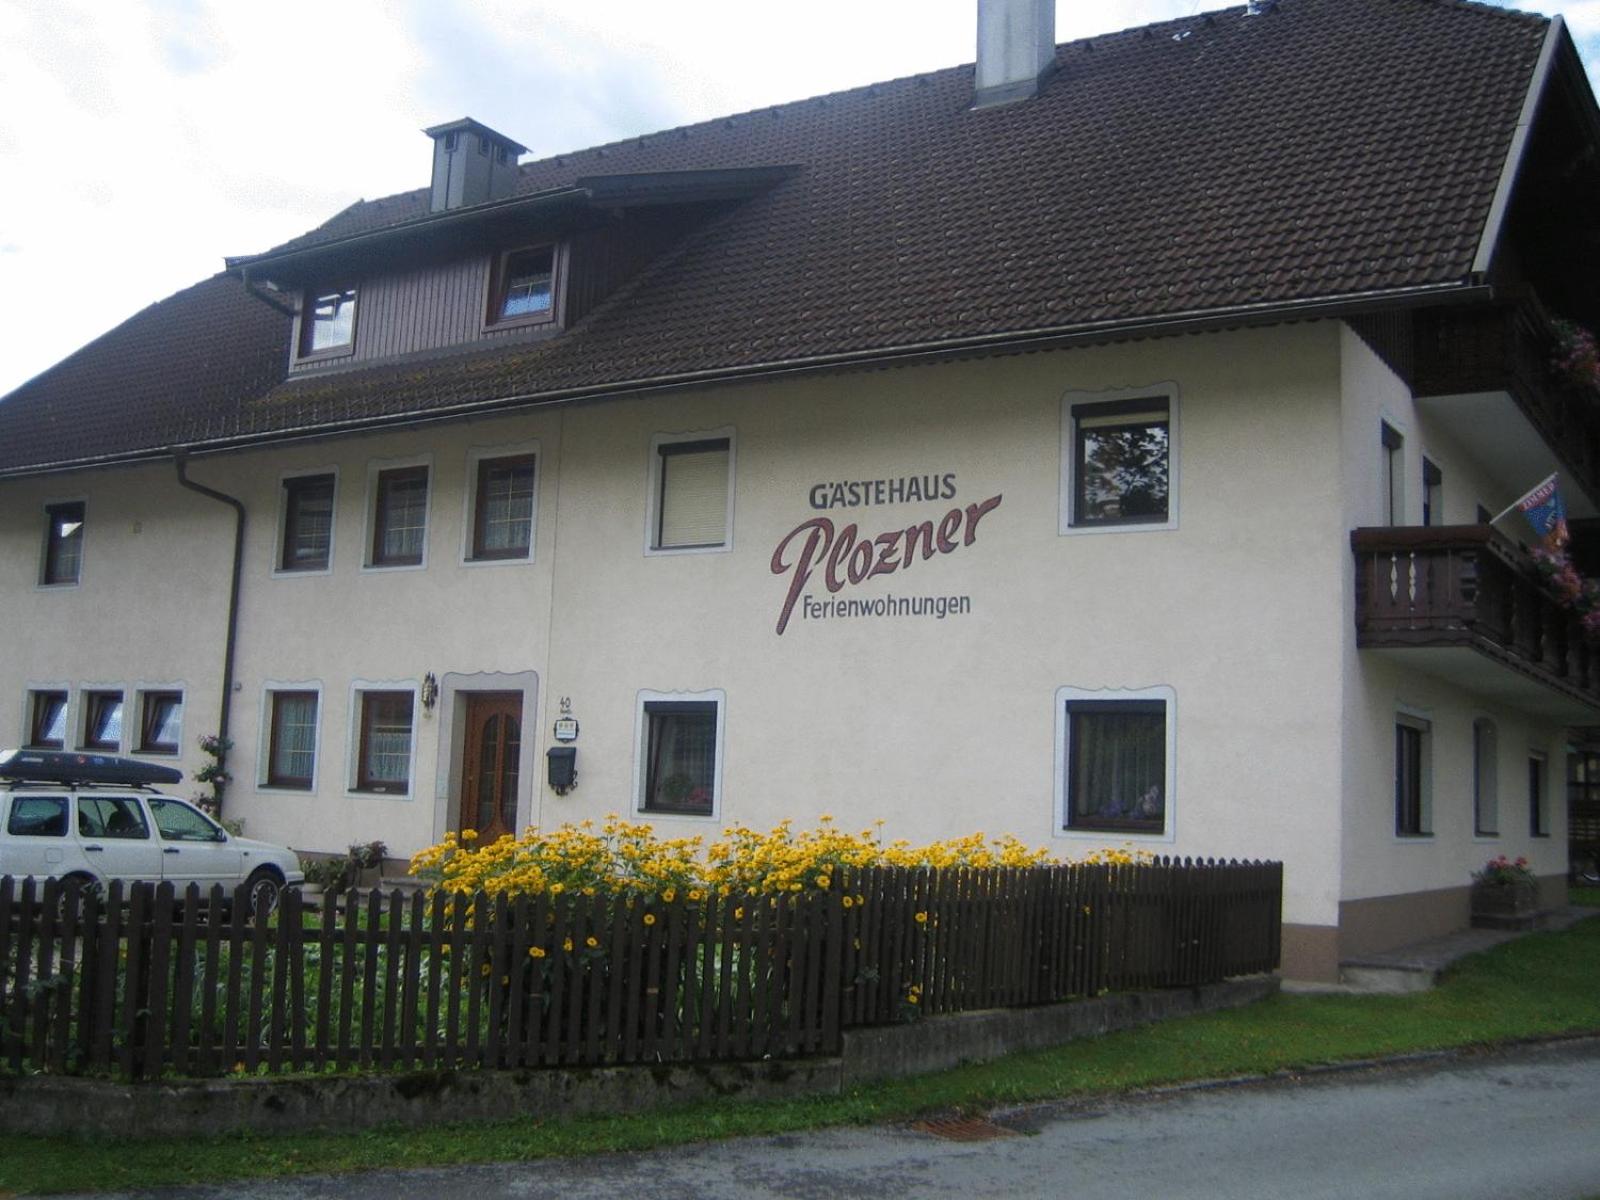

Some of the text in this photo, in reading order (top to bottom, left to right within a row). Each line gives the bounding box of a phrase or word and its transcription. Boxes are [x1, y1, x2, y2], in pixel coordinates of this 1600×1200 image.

[809, 473, 957, 510] GÄSTEHAUS
[770, 494, 1003, 636] Plozner
[803, 594, 971, 620] Ferienwohnungen
